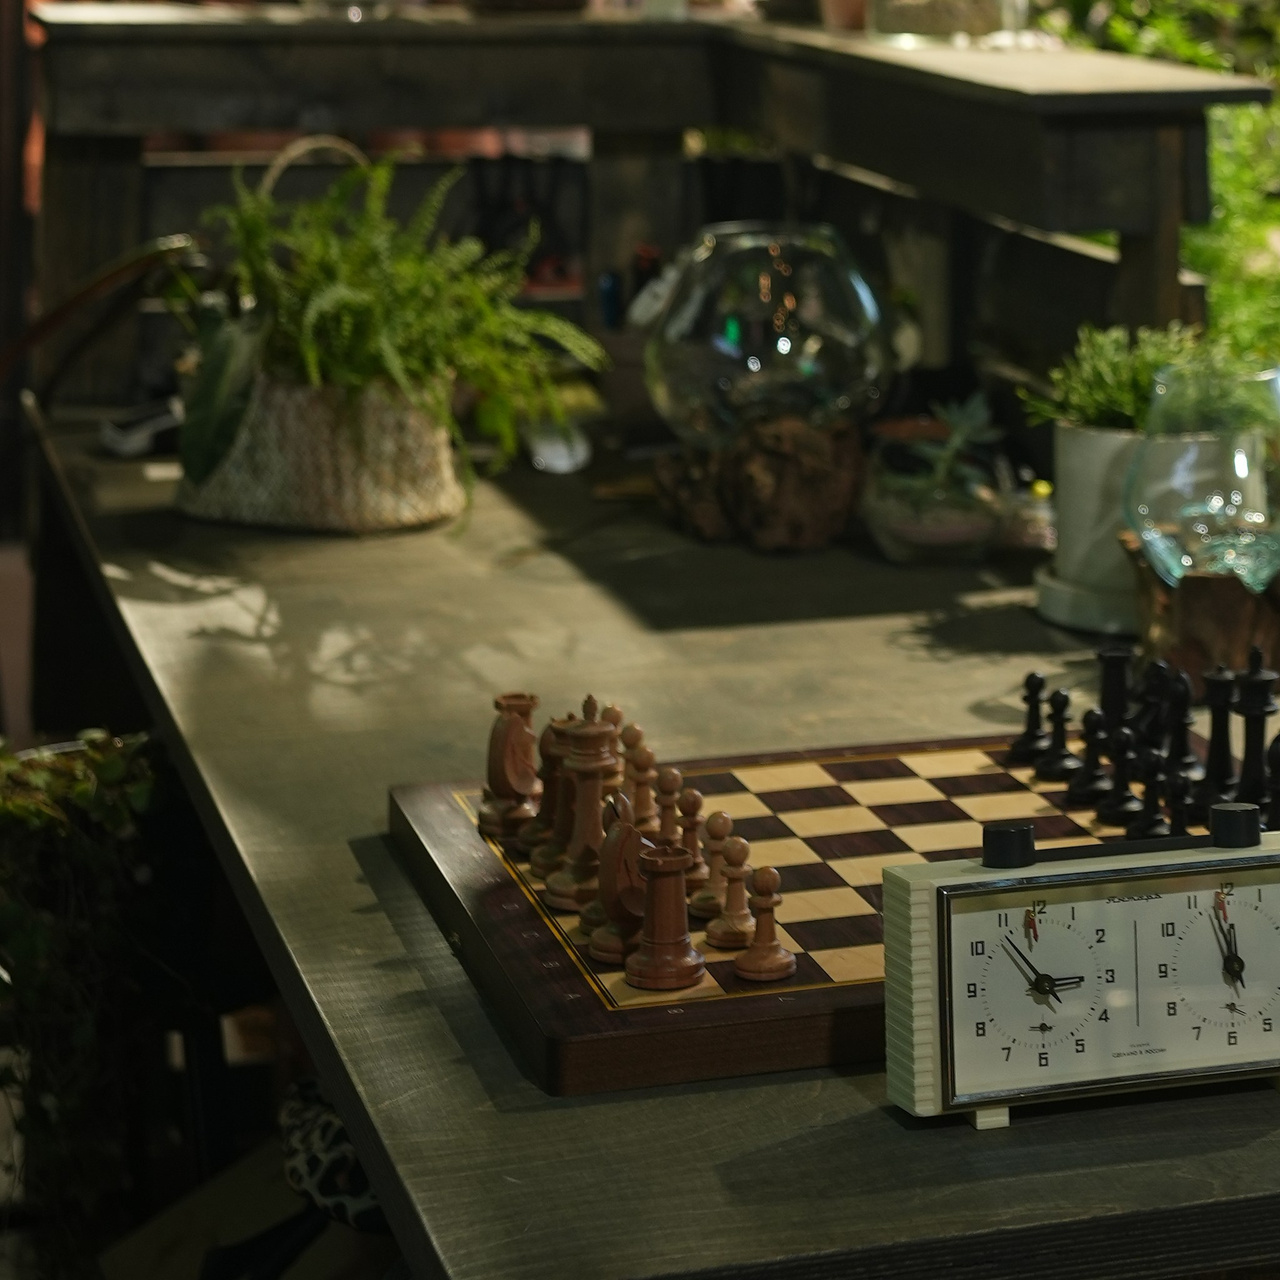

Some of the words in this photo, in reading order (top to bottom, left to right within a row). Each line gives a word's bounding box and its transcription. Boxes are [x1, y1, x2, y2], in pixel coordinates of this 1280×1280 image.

[1220, 882, 1234, 896] 12
[1257, 888, 1262, 902] 1
[1032, 900, 1047, 914] 12
[1187, 895, 1198, 909] 11
[998, 913, 1008, 927] 11
[1071, 906, 1075, 920] 1
[1095, 929, 1105, 943] 2
[1161, 922, 1175, 937] 10
[971, 941, 985, 956] 10
[1105, 969, 1115, 983] 3
[1158, 963, 1168, 978] 9
[967, 983, 977, 998] 9
[1167, 1001, 1177, 1016] 8
[1098, 1009, 1110, 1023] 4
[976, 1022, 986, 1037] 8
[1262, 1018, 1272, 1032] 5
[1192, 1026, 1202, 1040] 7
[1227, 1031, 1238, 1046] 6
[1075, 1039, 1085, 1053] 5
[1002, 1047, 1012, 1061] 7
[1038, 1052, 1049, 1067] 6
